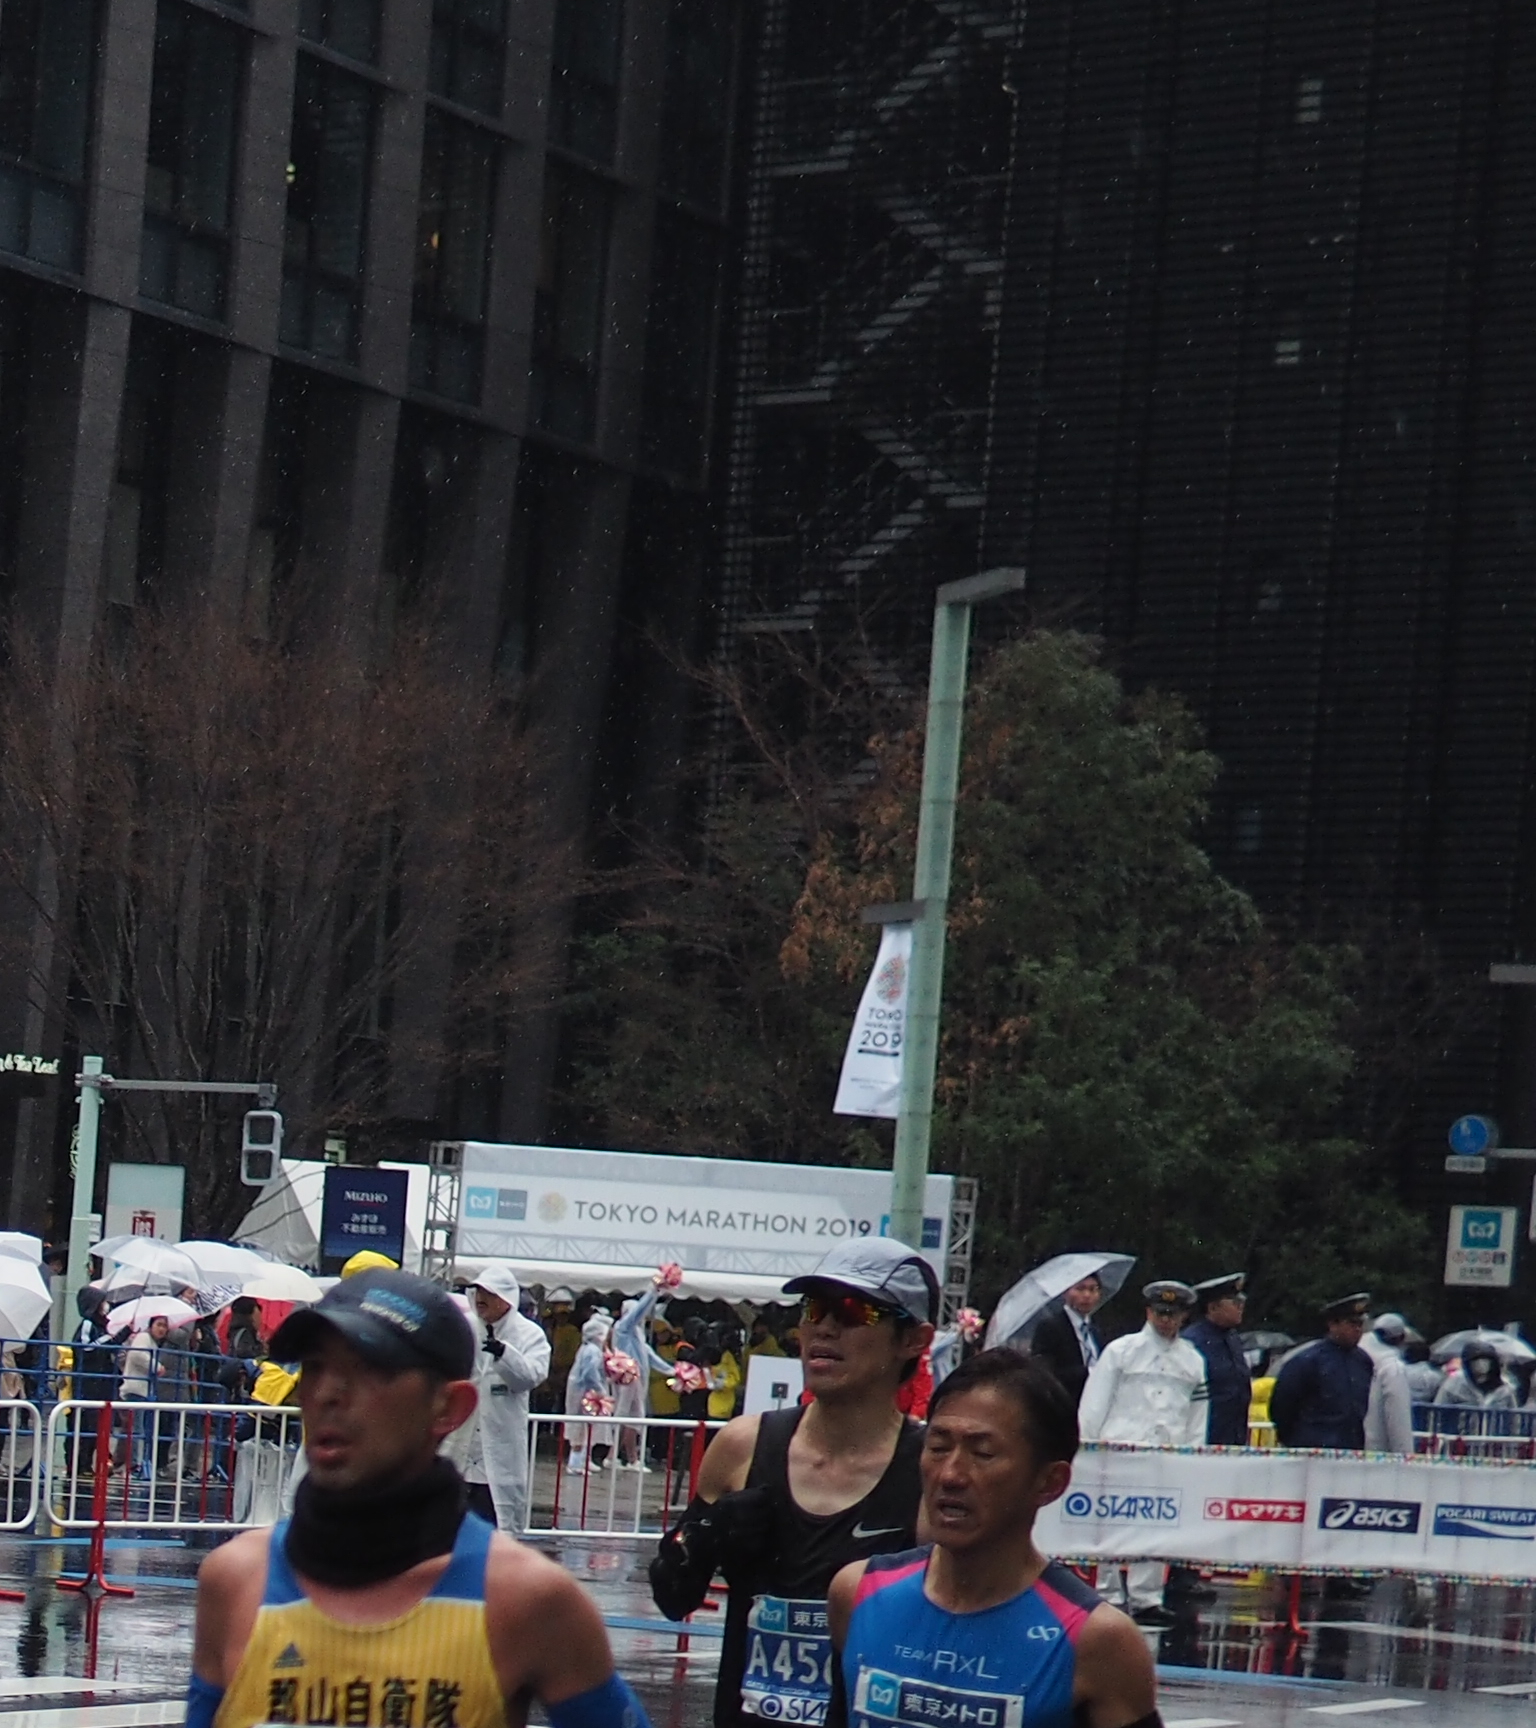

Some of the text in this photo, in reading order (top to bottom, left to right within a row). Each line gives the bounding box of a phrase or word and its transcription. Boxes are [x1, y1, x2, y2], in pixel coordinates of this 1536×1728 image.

[14, 1054, 33, 1072] Tea
[574, 1200, 872, 1238] TOKYO MARATHON 2019
[1353, 1507, 1413, 1528] asics
[1437, 1507, 1536, 1523] POCARI SWEAT
[904, 1692, 998, 1726] 東京メトロ
